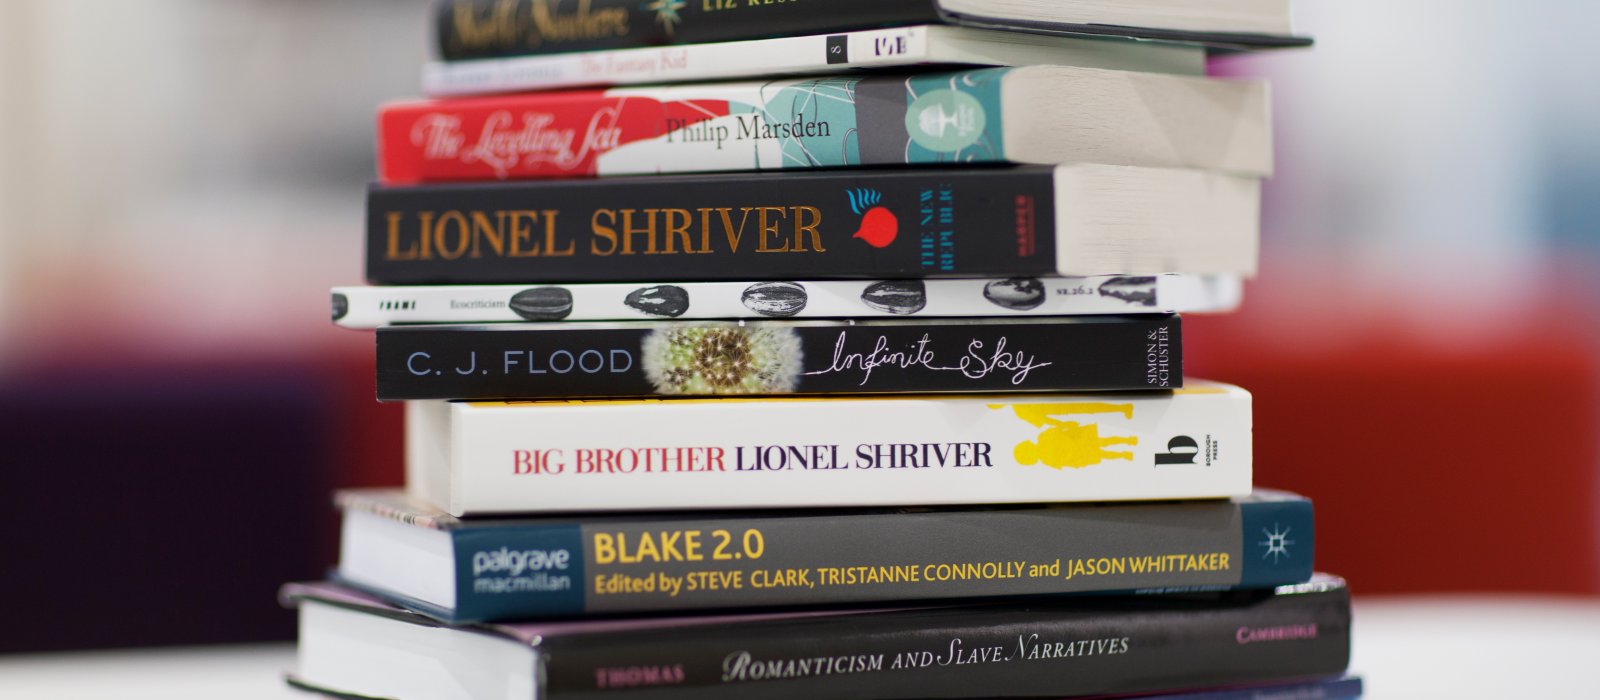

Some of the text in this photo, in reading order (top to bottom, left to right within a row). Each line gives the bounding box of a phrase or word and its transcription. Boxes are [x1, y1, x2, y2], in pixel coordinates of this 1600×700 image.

[666, 112, 831, 150] Philip Marsden
[384, 206, 826, 261] LIONEL SHRIVER
[919, 187, 935, 269] THE NEW
[406, 349, 634, 376] C. J. FLOOD
[827, 331, 1053, 386] Infinite Sky
[1147, 330, 1158, 384] SIMON &
[1158, 326, 1169, 387] SCHUSTER
[513, 442, 994, 475] BIG BROTHER LIONEL SHRIVER
[472, 546, 570, 575] palgrave
[593, 528, 765, 565] BLAKE 2.0
[473, 572, 571, 594] macmillan
[594, 553, 1231, 597] Edited by STEVE CLARK, TRISTANNE CONNOLLY and JASON WHITTAKER
[594, 663, 686, 689] THOMAS
[890, 651, 934, 670] AND
